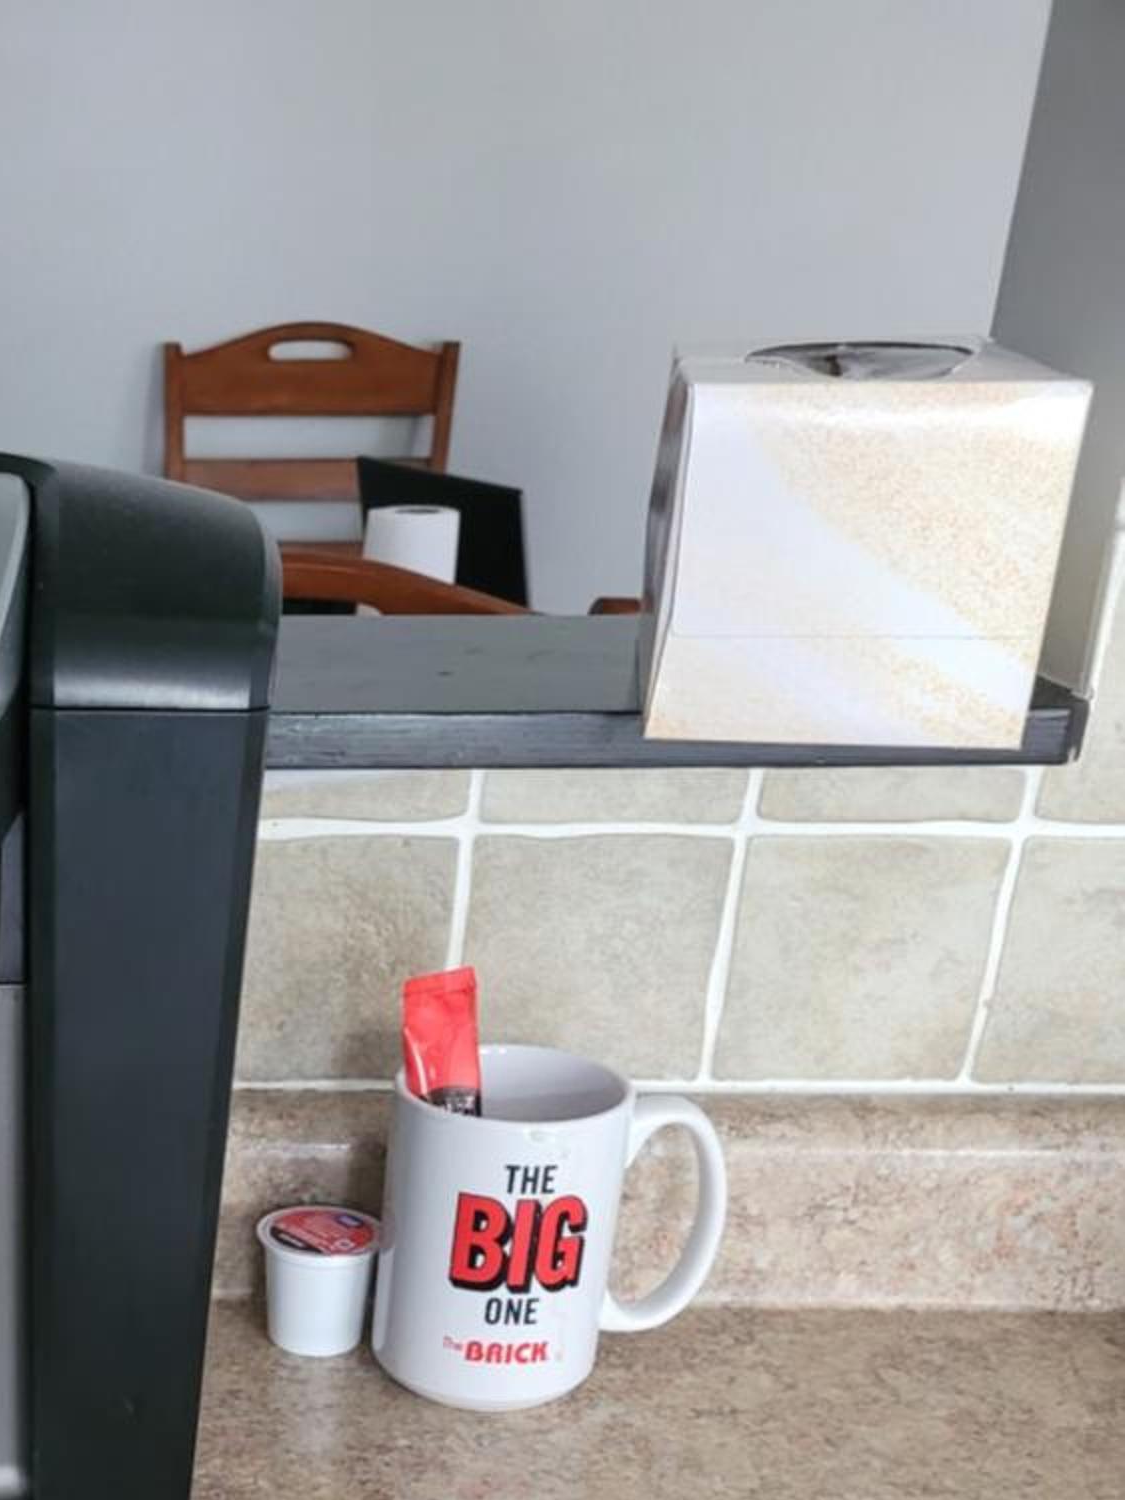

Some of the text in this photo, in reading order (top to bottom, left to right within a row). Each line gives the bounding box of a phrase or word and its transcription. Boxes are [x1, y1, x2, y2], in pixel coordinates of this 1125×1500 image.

[504, 1164, 558, 1195] THE
[448, 1191, 588, 1293] BIG
[483, 1297, 539, 1326] ONE
[465, 1340, 549, 1364] BRICK
